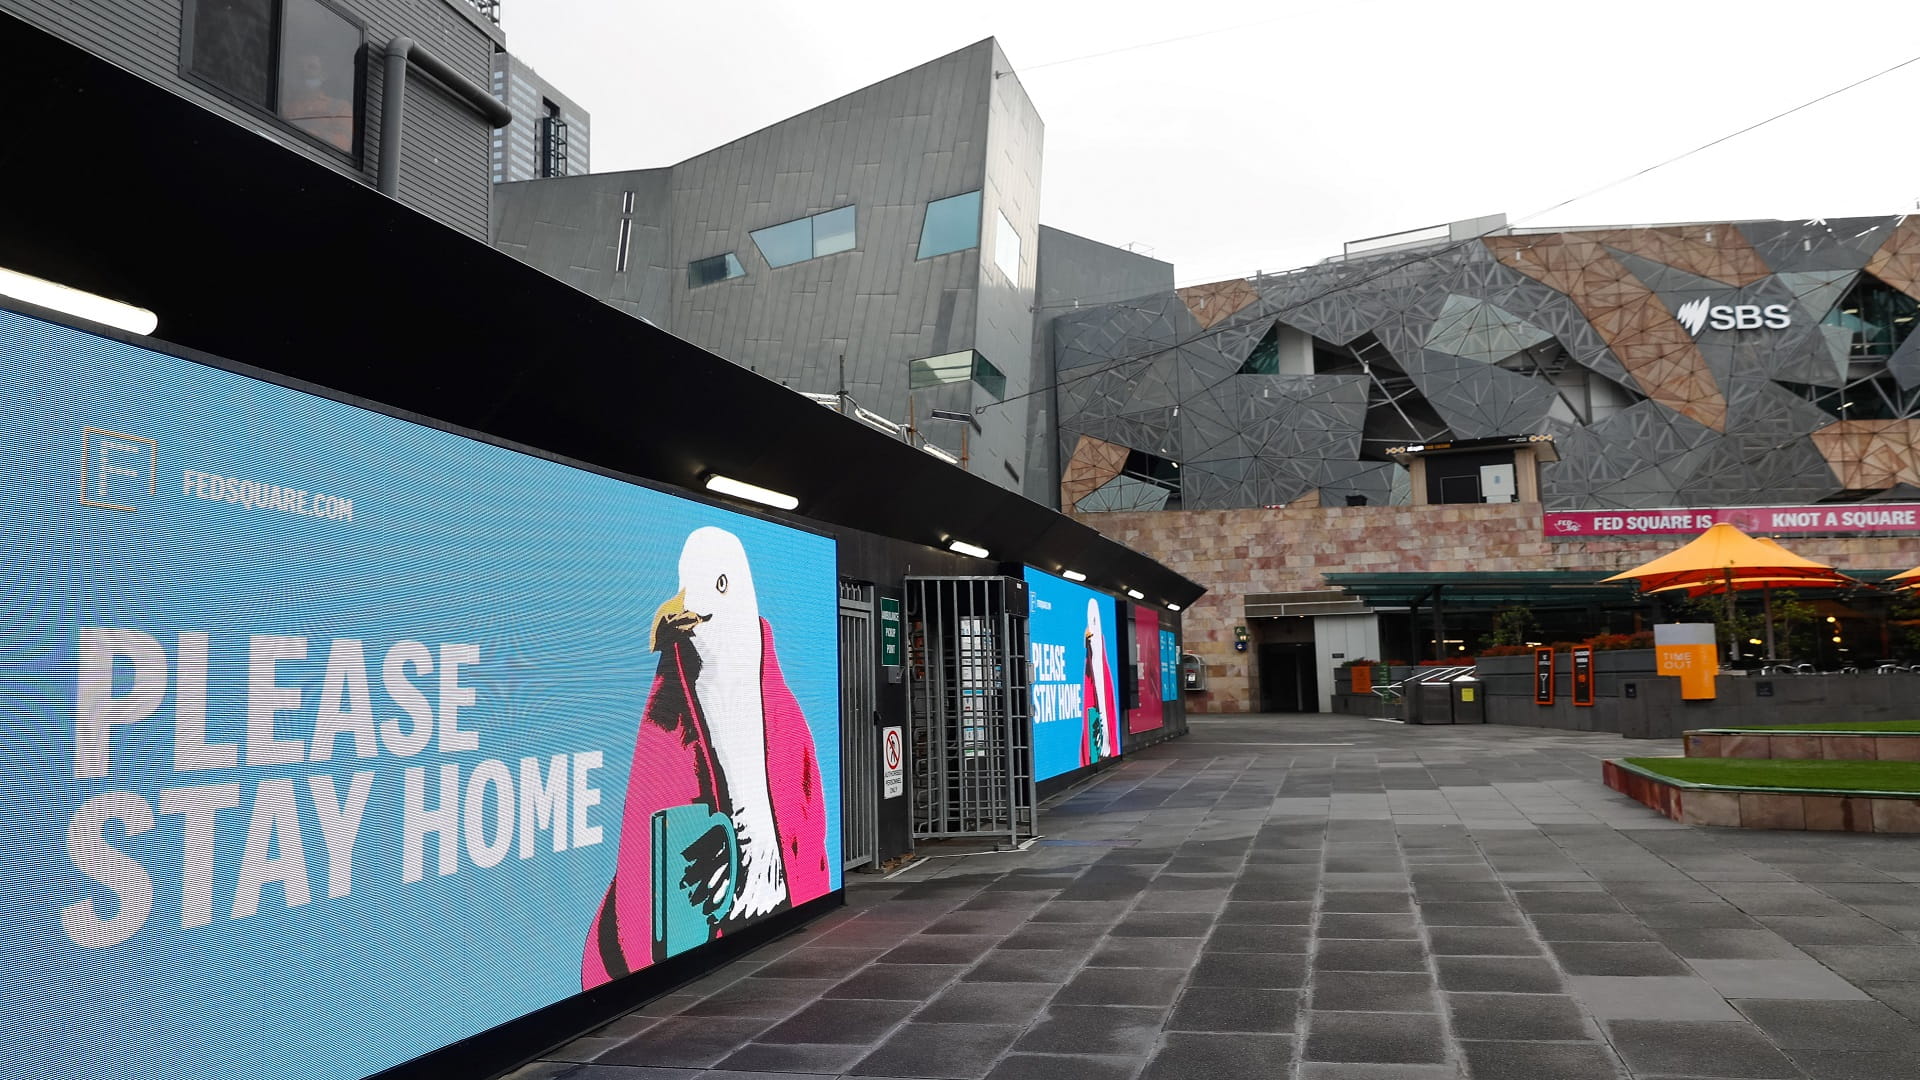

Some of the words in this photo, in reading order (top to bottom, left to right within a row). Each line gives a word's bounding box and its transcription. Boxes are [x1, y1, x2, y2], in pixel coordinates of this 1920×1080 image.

[1710, 304, 1791, 330] SBS
[182, 469, 354, 521] FEDSQUARE.COM
[1594, 516, 1623, 531] FED
[1626, 515, 1692, 532] SQUARE
[1696, 514, 1713, 529] IS
[1772, 512, 1821, 528] KNOT
[1824, 511, 1838, 527] A
[1842, 510, 1916, 528] SQUARE
[1032, 642, 1066, 681] PLEASE
[1663, 652, 1692, 661] TIME
[1663, 661, 1692, 670] OUT
[73, 625, 480, 779] PLEASE
[1033, 684, 1057, 724] STAY
[1058, 684, 1082, 720] HOME
[60, 769, 376, 949] STAY
[402, 750, 604, 885] HOME
